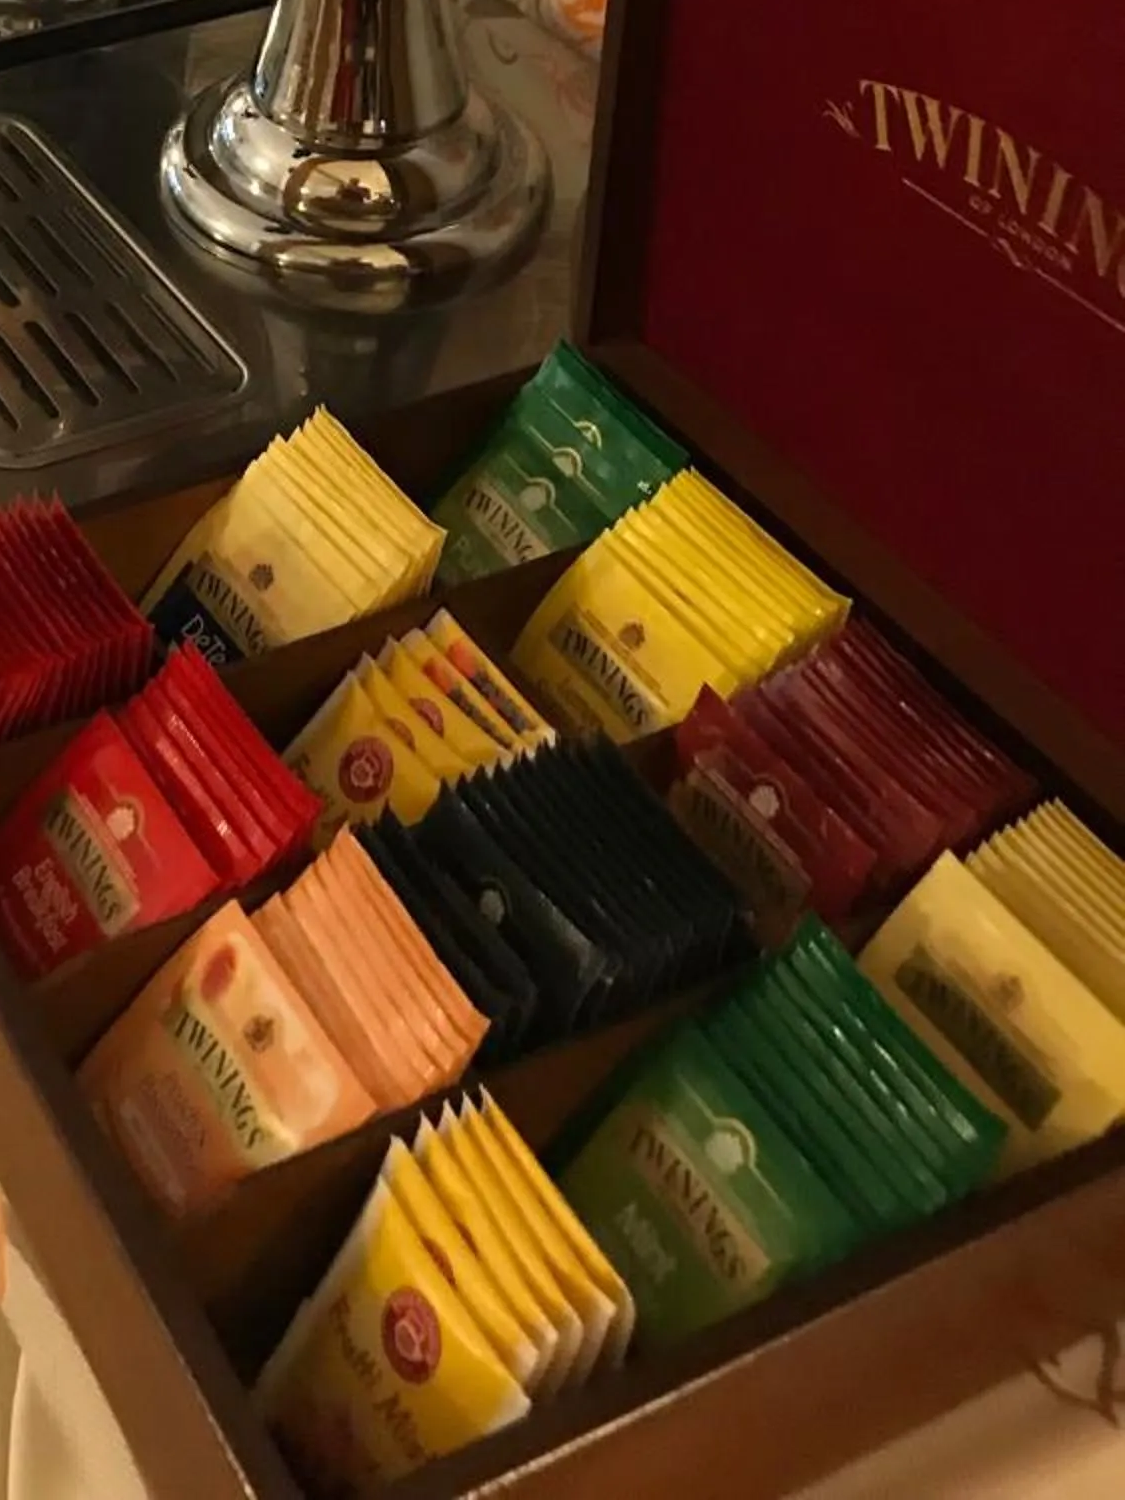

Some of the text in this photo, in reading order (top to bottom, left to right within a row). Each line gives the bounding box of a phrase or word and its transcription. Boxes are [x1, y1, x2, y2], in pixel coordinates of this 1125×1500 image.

[858, 78, 1125, 300] TWININ
[560, 626, 648, 727] TWININGS
[174, 1011, 265, 1151] TWININGS
